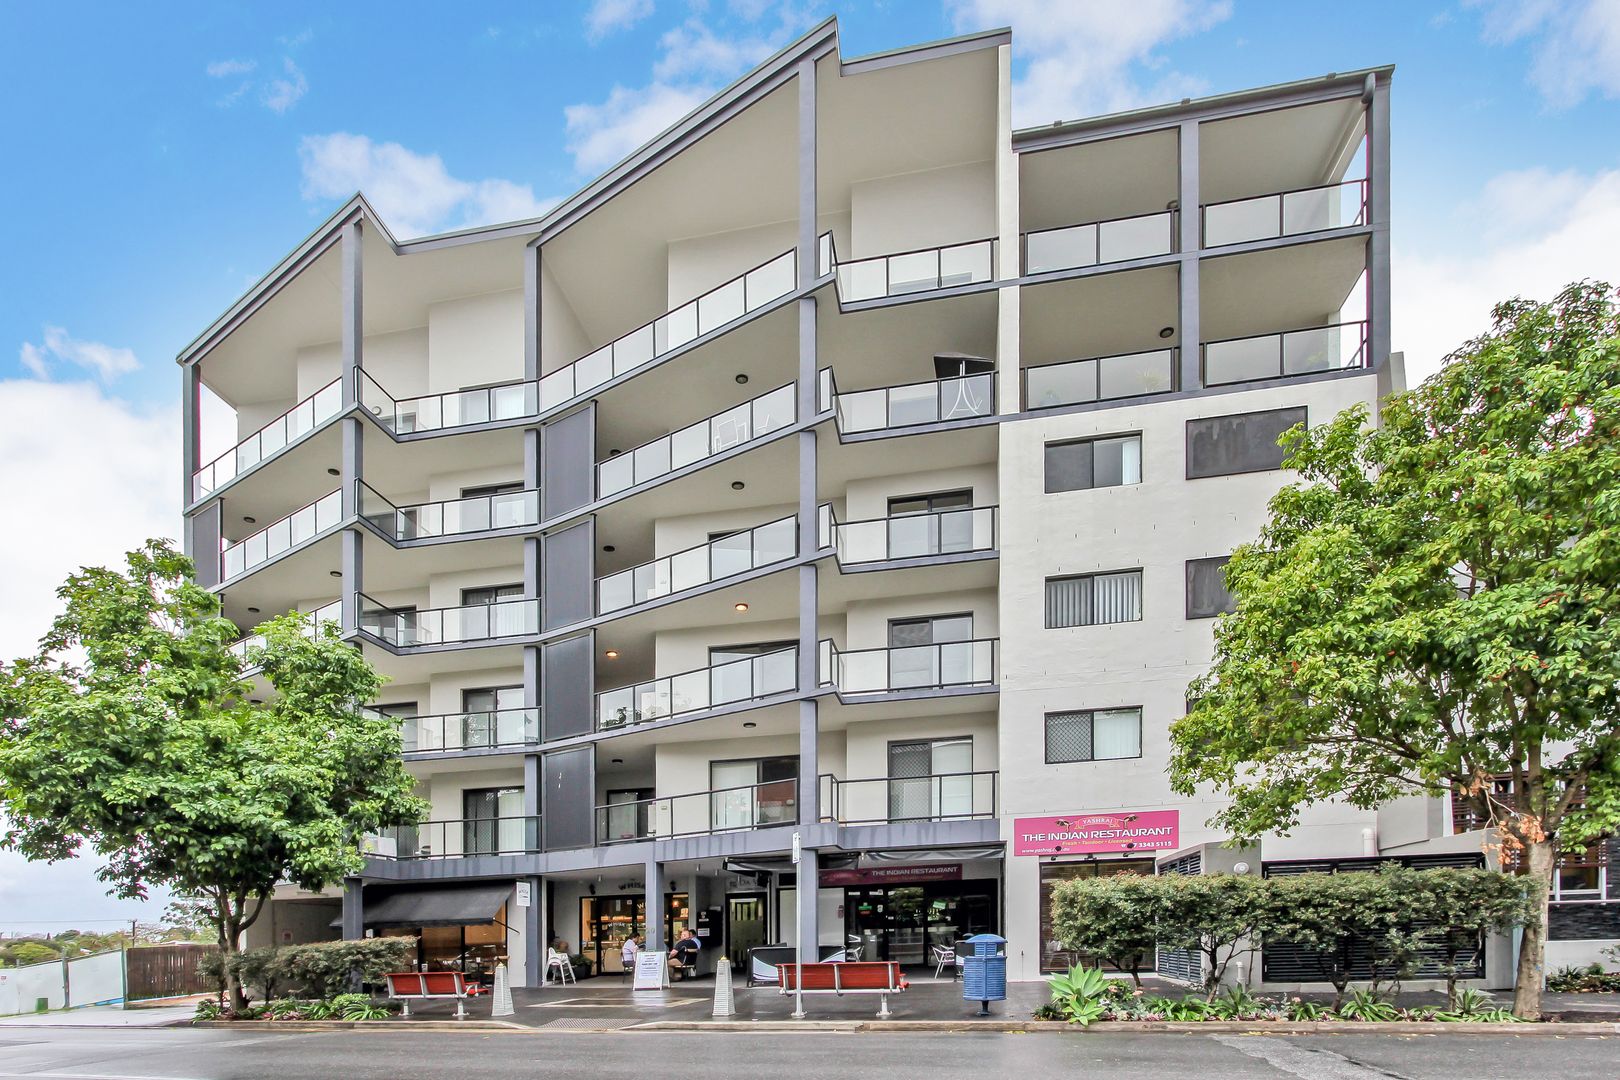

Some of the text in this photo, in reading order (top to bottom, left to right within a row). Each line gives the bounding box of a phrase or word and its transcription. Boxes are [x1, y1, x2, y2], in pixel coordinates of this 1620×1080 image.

[1022, 826, 1173, 842] THE INDIAN RESTAURANT
[910, 866, 958, 874] RESTAURANT
